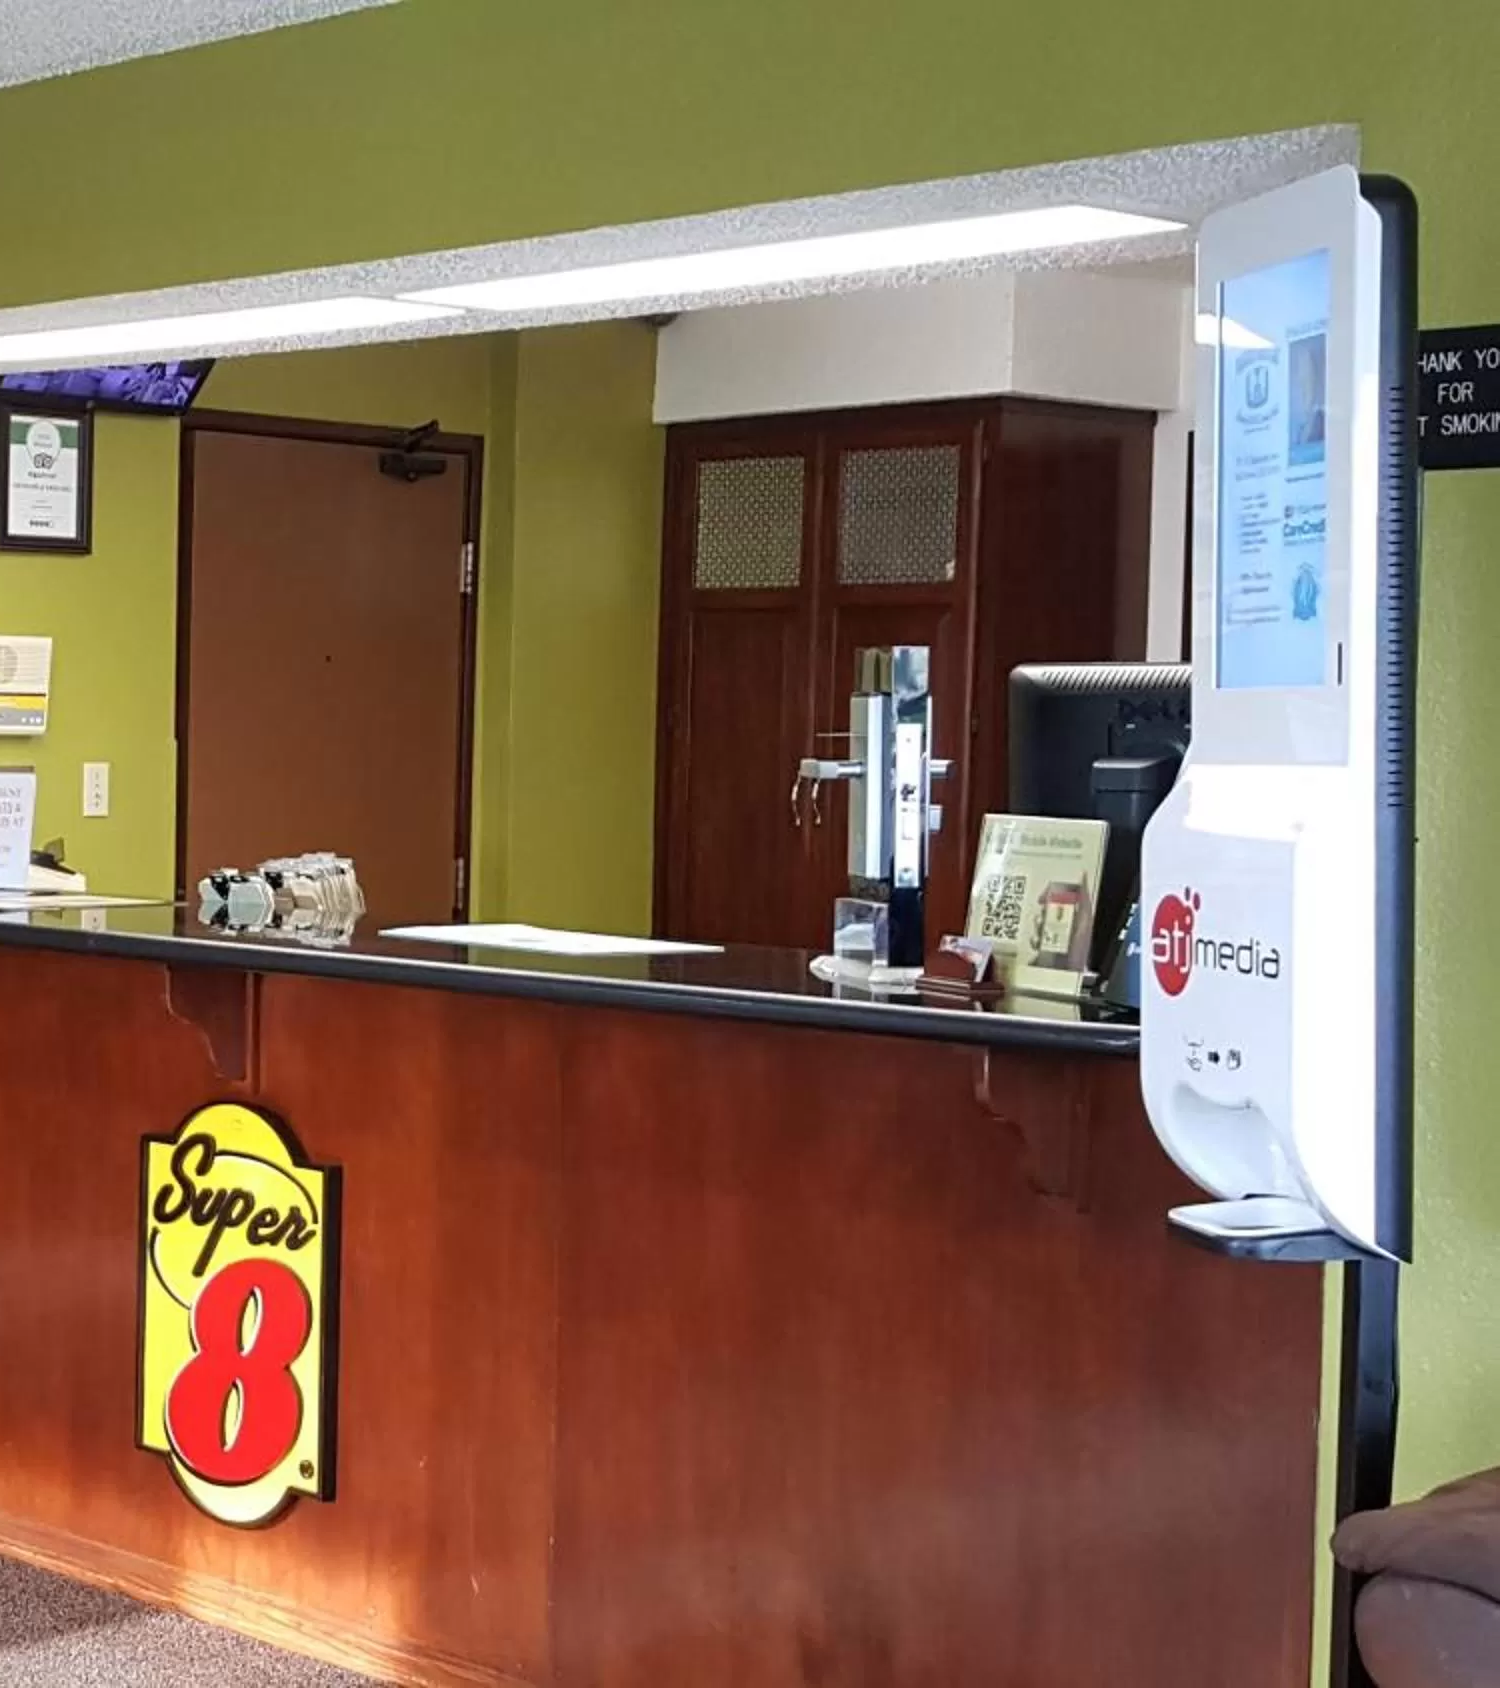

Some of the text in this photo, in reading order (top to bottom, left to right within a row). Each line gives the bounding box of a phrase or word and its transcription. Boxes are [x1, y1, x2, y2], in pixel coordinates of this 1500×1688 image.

[1416, 347, 1500, 373] HANK YO
[1437, 381, 1475, 405] FOR
[1441, 411, 1500, 436] SMOKI
[153, 1132, 318, 1278] Super
[165, 1257, 313, 1487] 8
